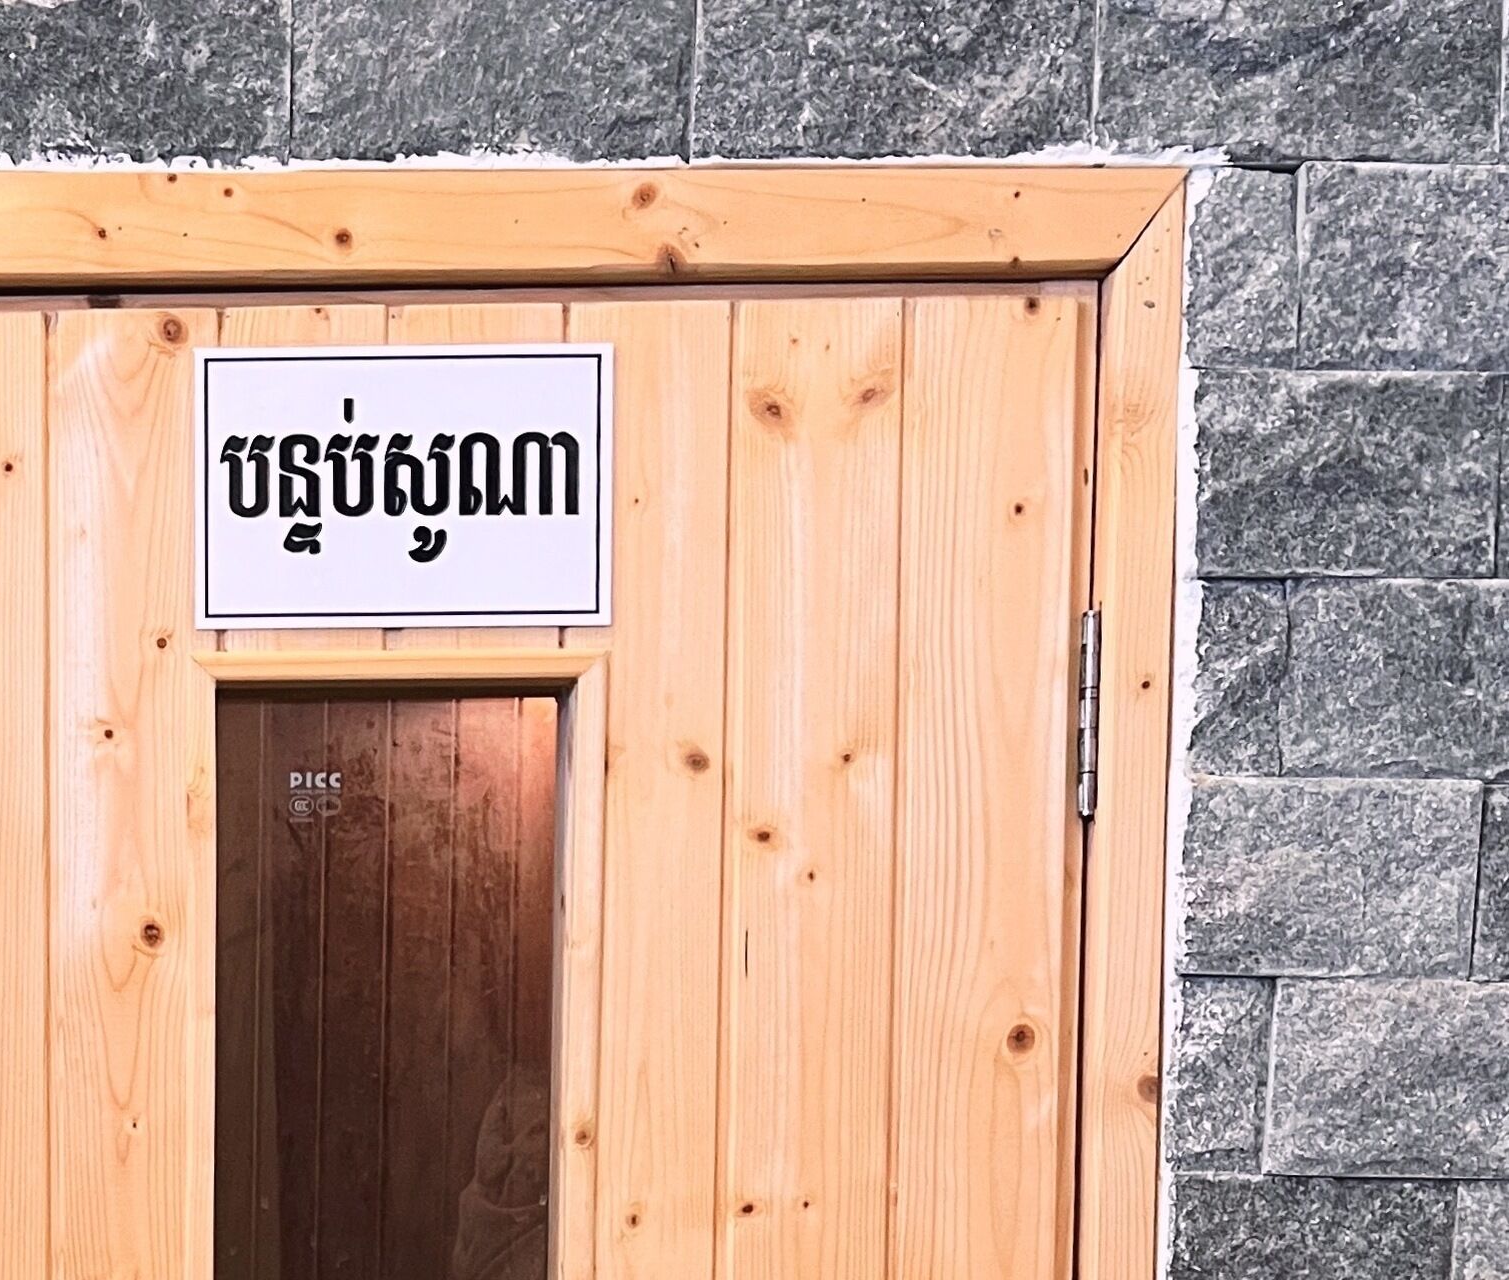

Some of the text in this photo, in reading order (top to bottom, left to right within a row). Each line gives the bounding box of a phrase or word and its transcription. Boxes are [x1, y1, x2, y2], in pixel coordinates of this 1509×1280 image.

[219, 397, 581, 563] បន្ទប់សូណា
[289, 771, 342, 789] PICC
